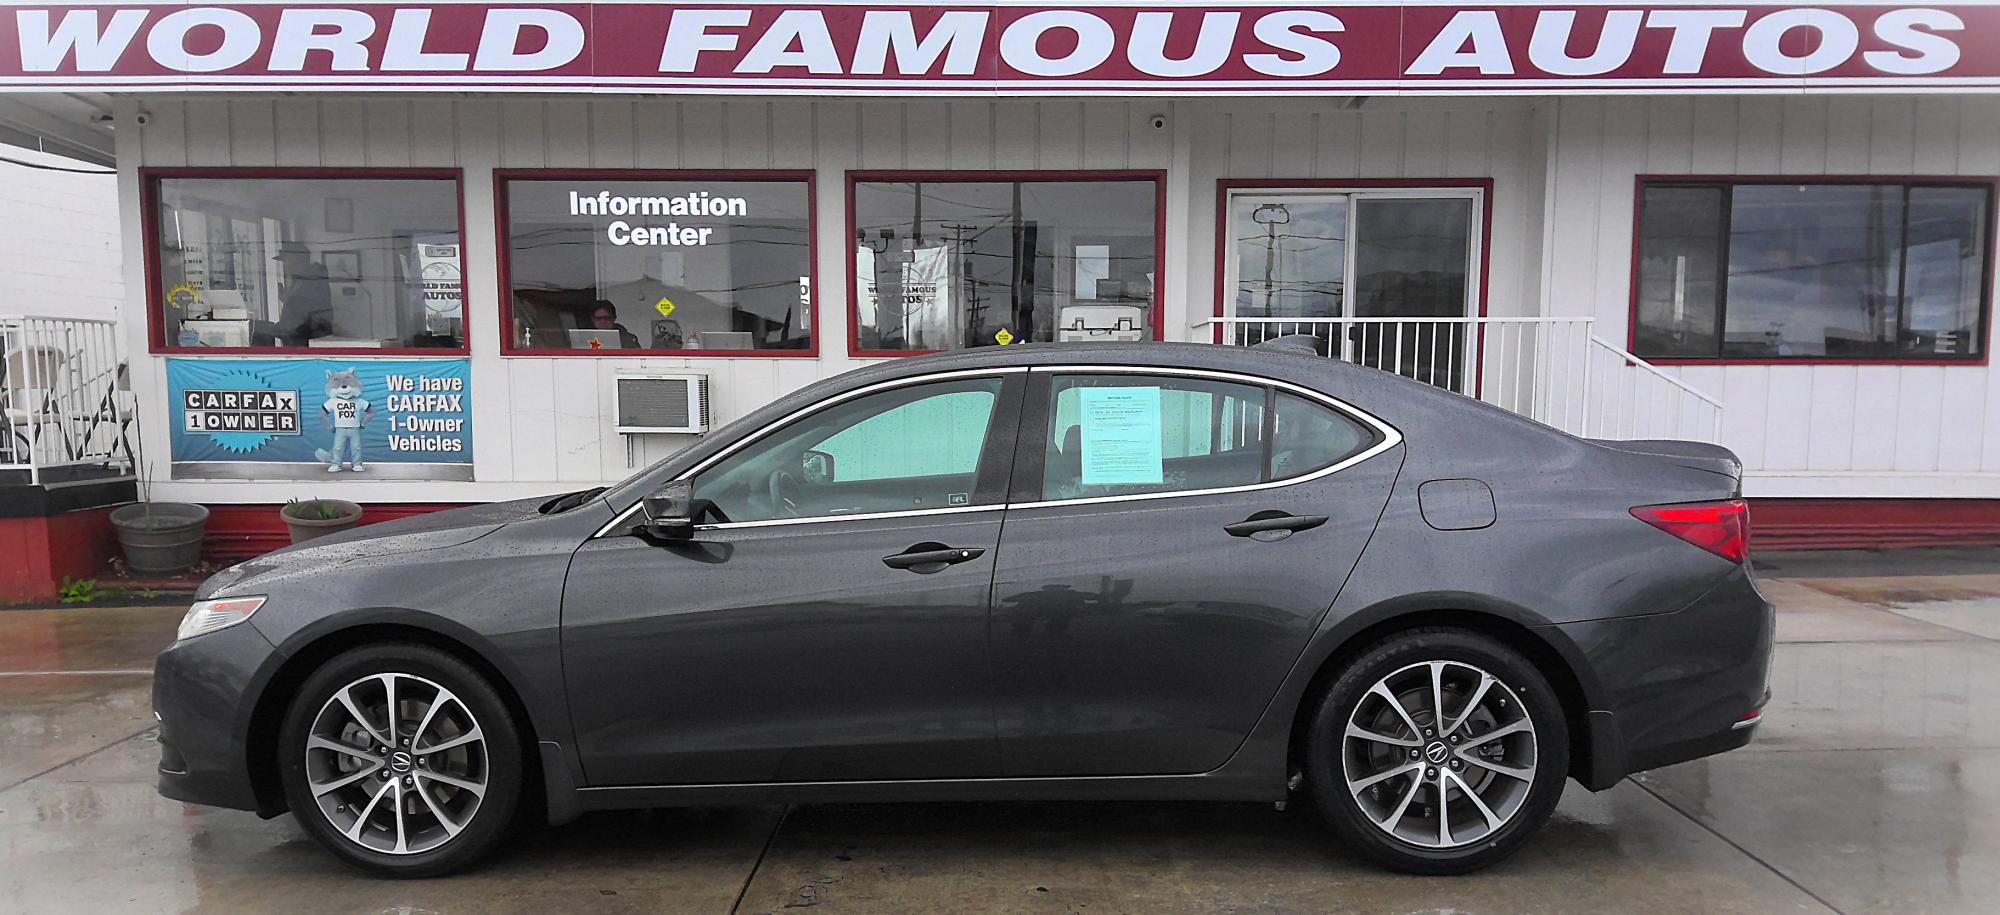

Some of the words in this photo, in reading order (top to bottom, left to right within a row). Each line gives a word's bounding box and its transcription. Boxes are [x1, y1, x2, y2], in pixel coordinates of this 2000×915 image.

[16, 8, 585, 72] WORLD
[658, 10, 1345, 76] FAMOUS
[1404, 8, 1965, 75] AUTOS
[569, 191, 747, 216] Information
[607, 221, 713, 246] Center
[386, 374, 414, 392] We
[420, 375, 463, 392] have
[188, 393, 293, 410] CARFAX
[336, 402, 357, 411] CAR
[387, 394, 463, 413] CARFAX
[338, 410, 356, 419] FOX
[388, 415, 464, 432] 1-Owner
[387, 435, 463, 452] Vehicles
